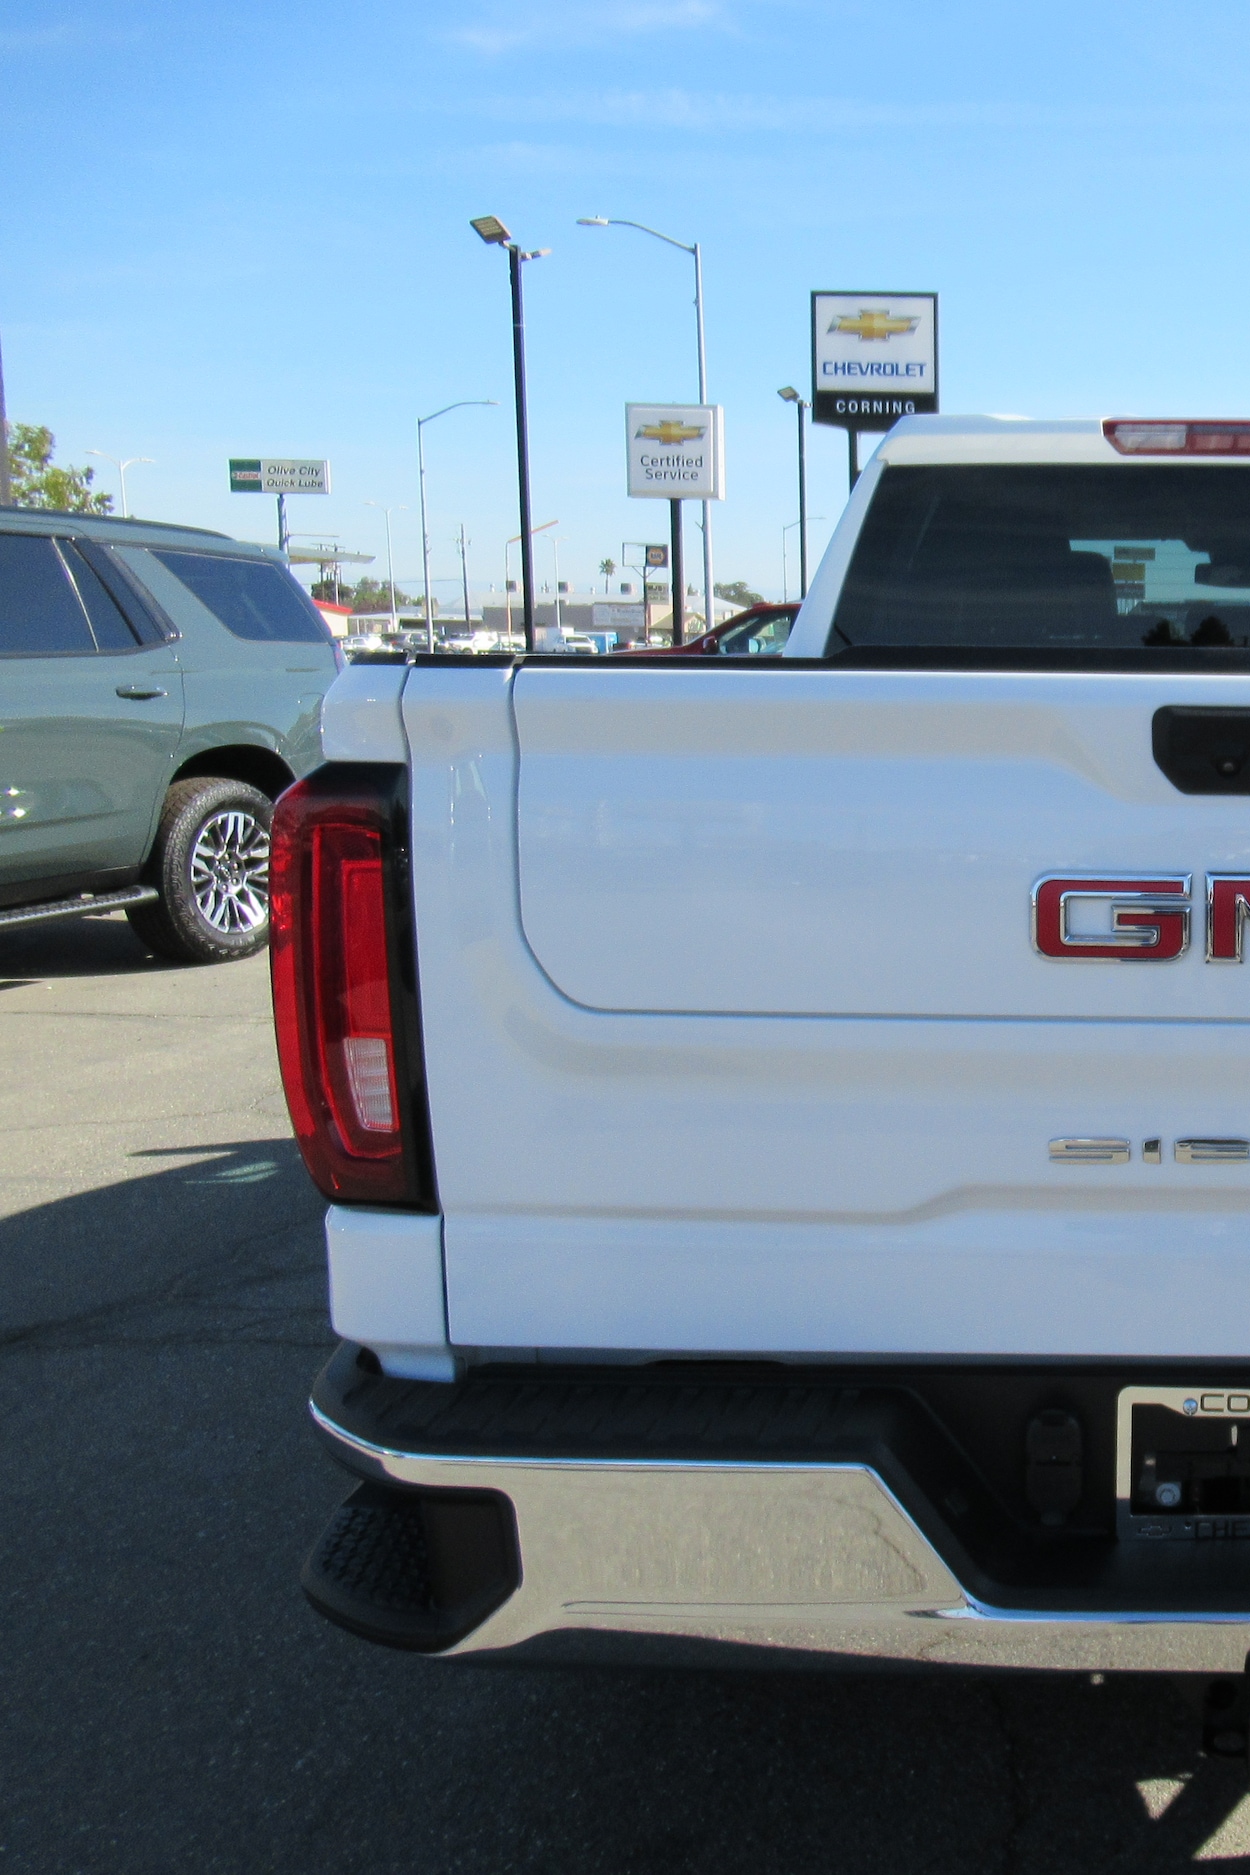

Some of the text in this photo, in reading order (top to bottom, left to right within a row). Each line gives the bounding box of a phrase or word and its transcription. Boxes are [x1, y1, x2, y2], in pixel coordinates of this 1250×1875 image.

[822, 361, 927, 377] CHEVROLET
[836, 400, 916, 414] CORNING
[640, 455, 703, 468] Certified
[267, 465, 320, 477] Olive City
[645, 468, 699, 480] Service
[267, 478, 323, 488] Quick Lube
